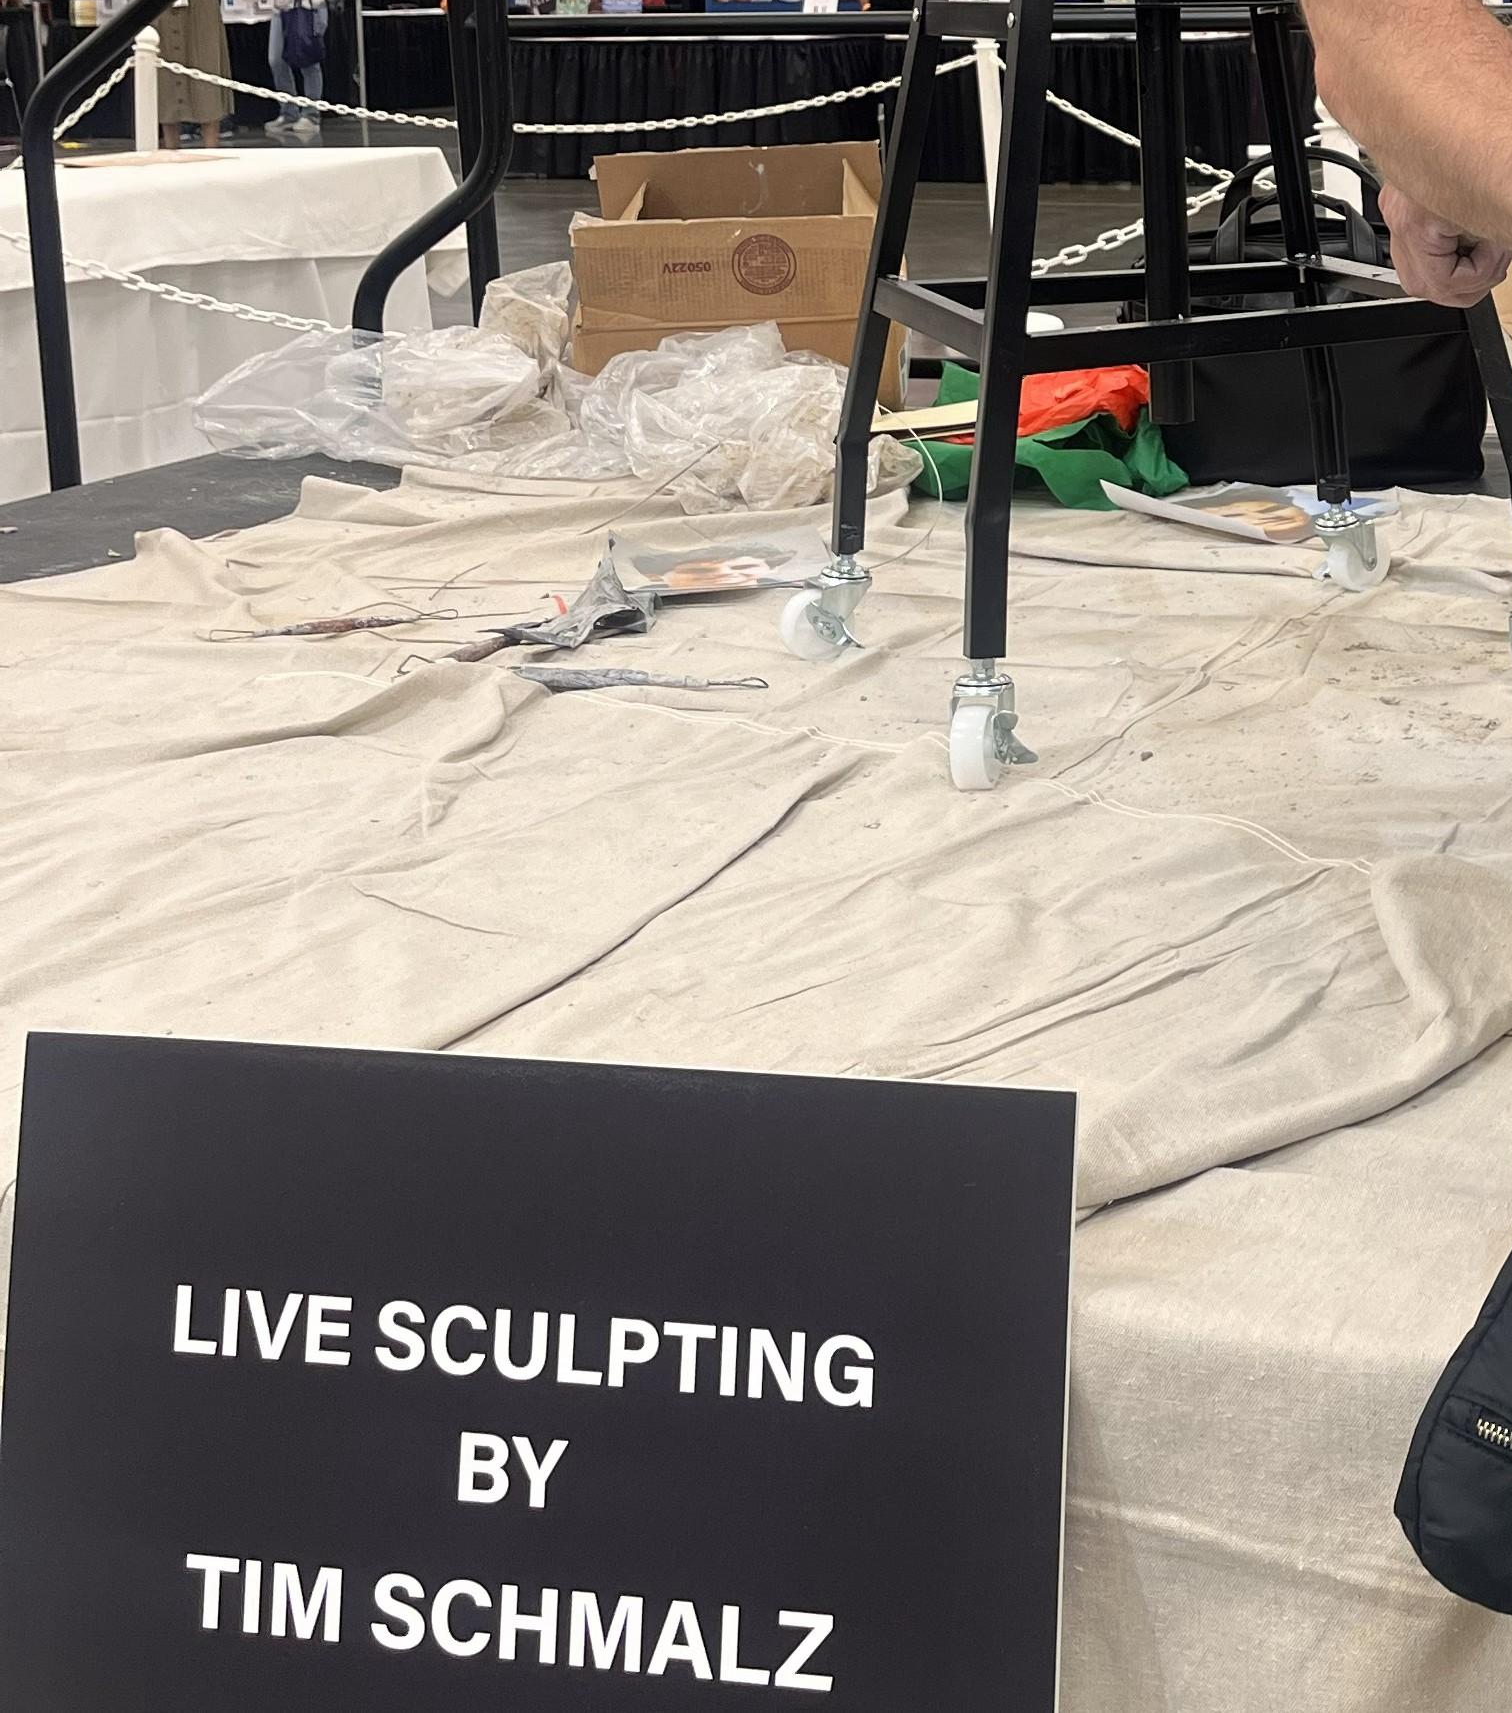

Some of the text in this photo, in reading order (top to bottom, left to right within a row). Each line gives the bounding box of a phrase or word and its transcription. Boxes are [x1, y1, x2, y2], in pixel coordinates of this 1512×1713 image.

[174, 1285, 874, 1407] LIVE SCULPTING
[458, 1432, 568, 1507] BY
[187, 1554, 833, 1691] TIM SCHMALZ
